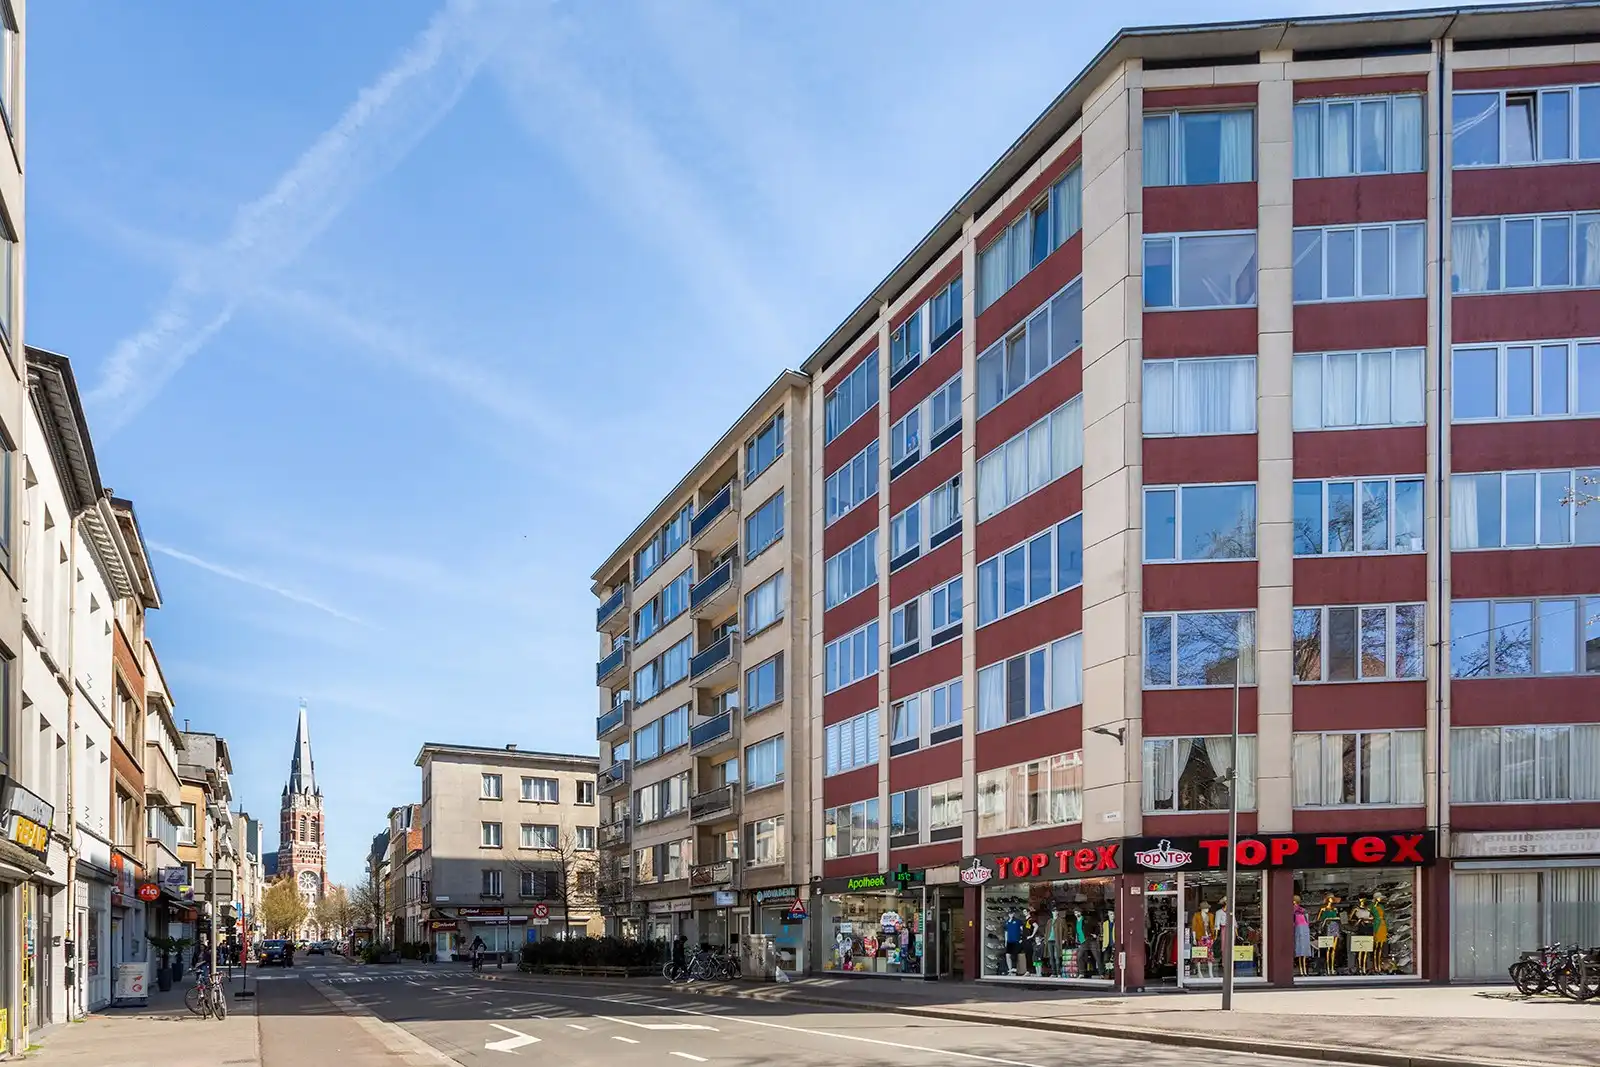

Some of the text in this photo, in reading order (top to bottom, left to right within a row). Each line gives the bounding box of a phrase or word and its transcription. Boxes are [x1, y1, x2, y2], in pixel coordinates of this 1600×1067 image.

[1199, 838, 1299, 867] TOP
[995, 853, 1049, 879] TOP
[141, 885, 158, 895] ria
[848, 875, 885, 890] Apotheek
